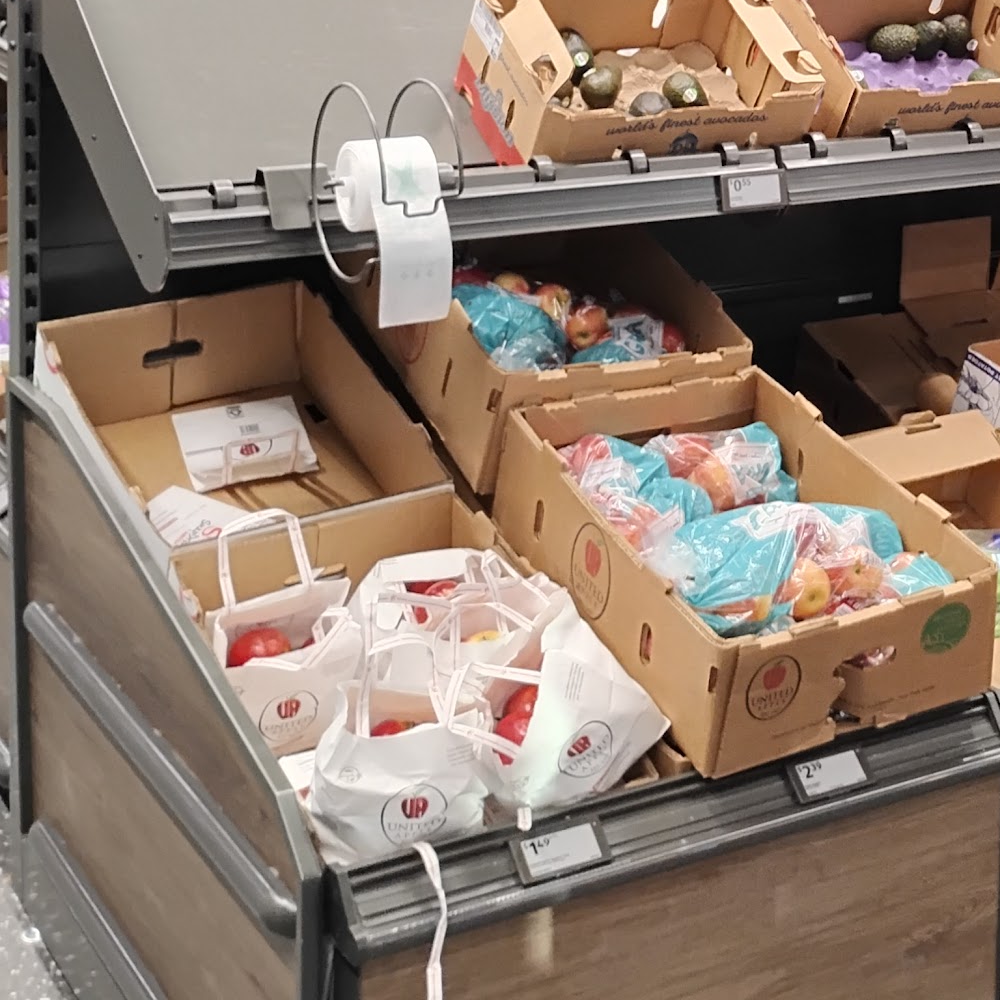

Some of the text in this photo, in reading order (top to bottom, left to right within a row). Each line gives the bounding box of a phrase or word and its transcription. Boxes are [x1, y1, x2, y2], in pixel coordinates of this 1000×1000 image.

[898, 101, 943, 115] world's
[944, 100, 980, 114] finest
[605, 112, 768, 136] world's finest avocados
